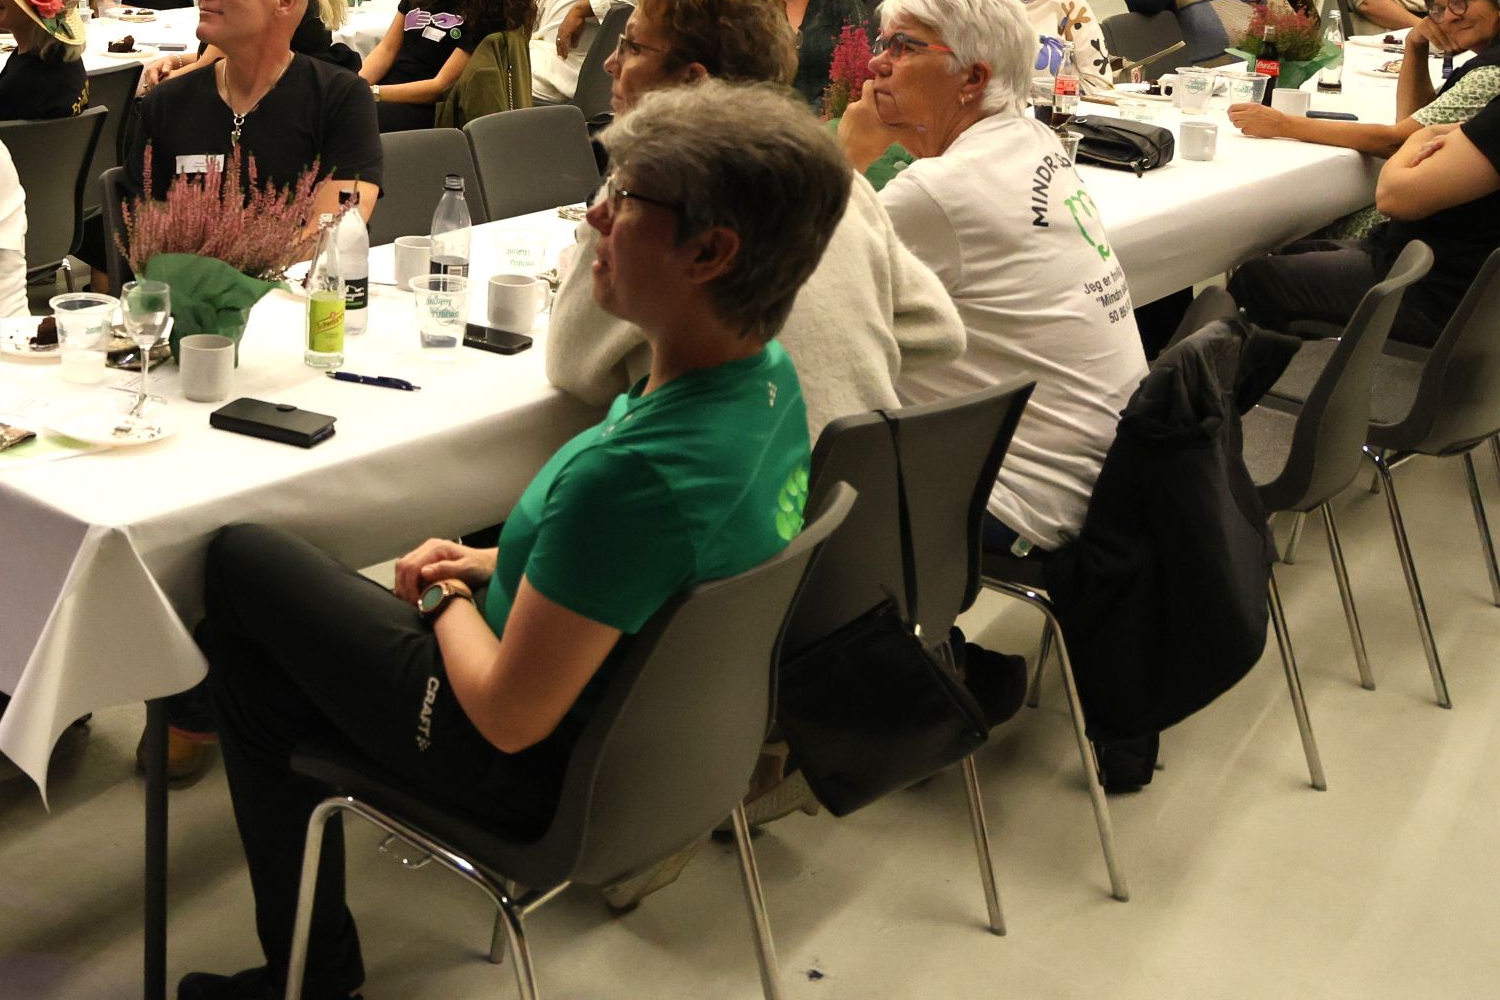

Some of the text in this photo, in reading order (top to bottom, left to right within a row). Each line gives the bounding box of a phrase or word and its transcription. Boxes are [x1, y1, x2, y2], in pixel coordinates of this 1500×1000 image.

[1084, 275, 1112, 295] Jeg er
[1108, 309, 1120, 324] 50
[417, 675, 441, 738] CRAFT
